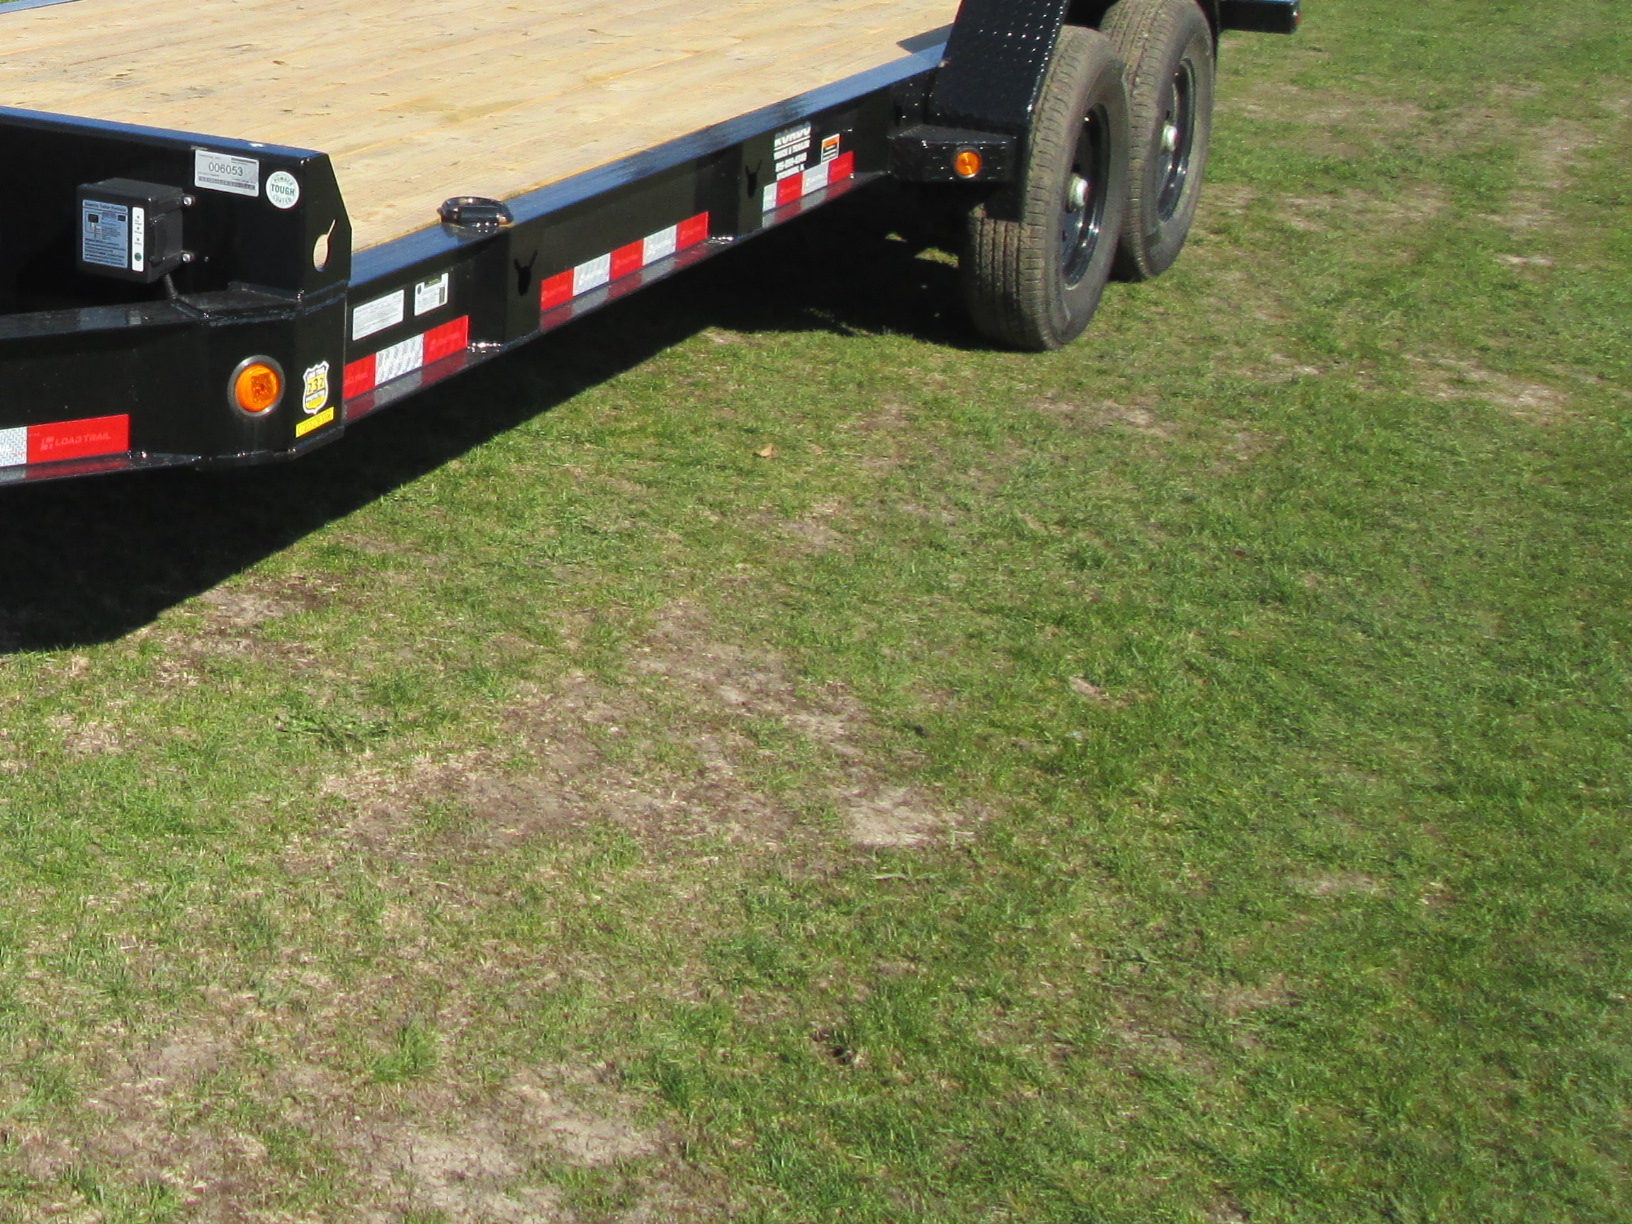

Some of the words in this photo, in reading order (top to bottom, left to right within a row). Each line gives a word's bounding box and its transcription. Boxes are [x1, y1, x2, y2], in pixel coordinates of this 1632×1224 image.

[208, 161, 244, 177] 006053
[270, 183, 296, 196] TOUGH
[307, 377, 324, 393] 232
[55, 436, 84, 447] LOAD
[83, 432, 111, 444] TRAIL
